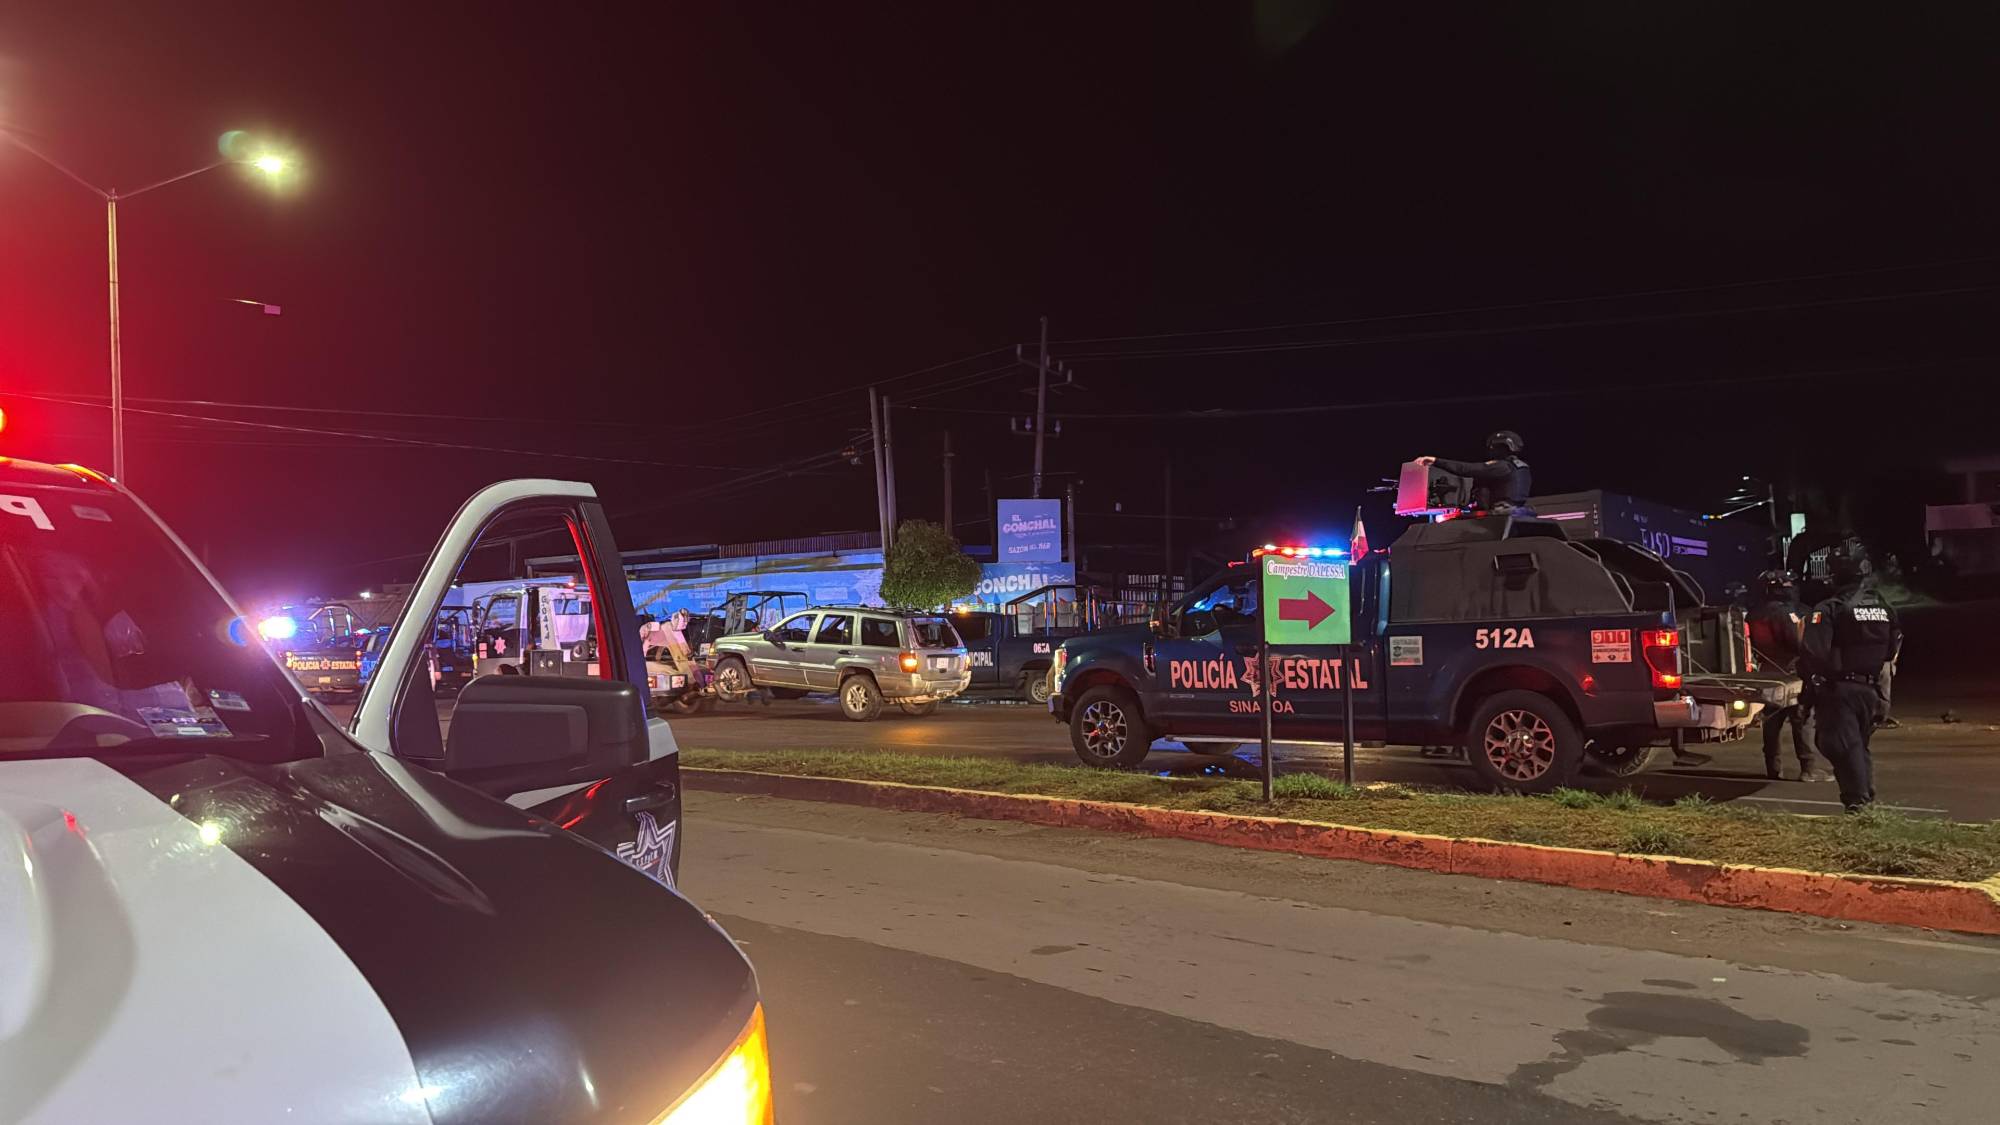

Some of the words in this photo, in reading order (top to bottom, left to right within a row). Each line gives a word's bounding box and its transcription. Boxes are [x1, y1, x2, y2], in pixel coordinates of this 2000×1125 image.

[1003, 519, 1056, 533] CONCHAL
[1267, 560, 1308, 579] Campestre
[1475, 627, 1535, 649] 512A
[1593, 631, 1627, 643] 911
[1171, 654, 1238, 689] POLICÍA
[1229, 700, 1295, 714] SINAOA
